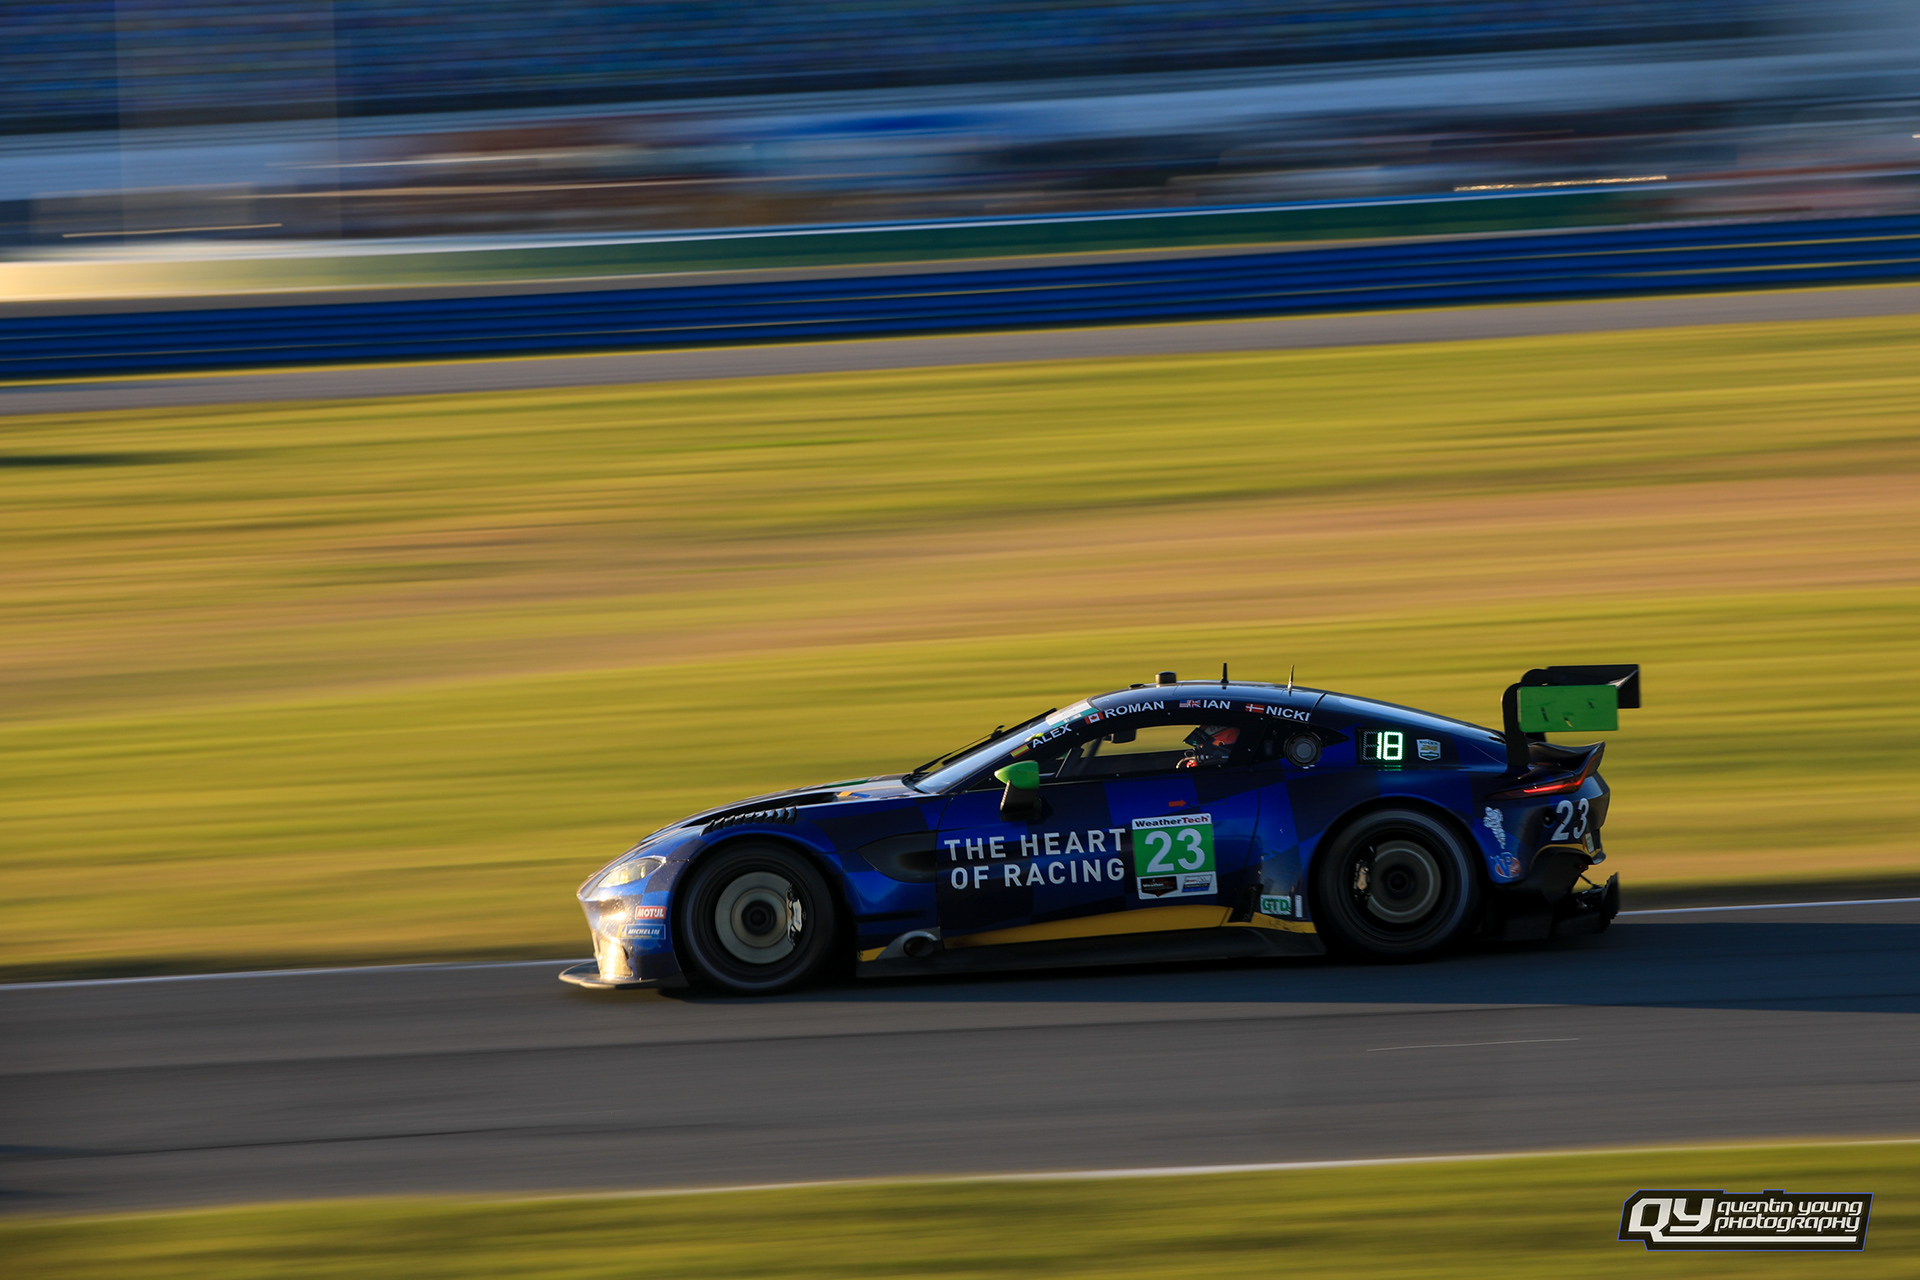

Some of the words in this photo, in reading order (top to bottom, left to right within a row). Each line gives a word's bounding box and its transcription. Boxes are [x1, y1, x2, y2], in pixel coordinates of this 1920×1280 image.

[1104, 701, 1165, 719] ROMAN
[1203, 700, 1231, 710] IAN
[1265, 705, 1311, 722] NICKI
[1032, 723, 1072, 748] ALEX
[1376, 731, 1403, 760] 18
[1134, 815, 1209, 828] WeatherTech
[1550, 797, 1590, 841] 23
[944, 835, 1007, 861] THE
[1020, 828, 1126, 857] HEART
[1144, 828, 1206, 873] 23
[951, 865, 990, 890] OF
[1003, 858, 1125, 888] RACING
[637, 908, 665, 918] MOTUL
[1262, 898, 1290, 911] GTD
[627, 928, 661, 936] MICHELIN
